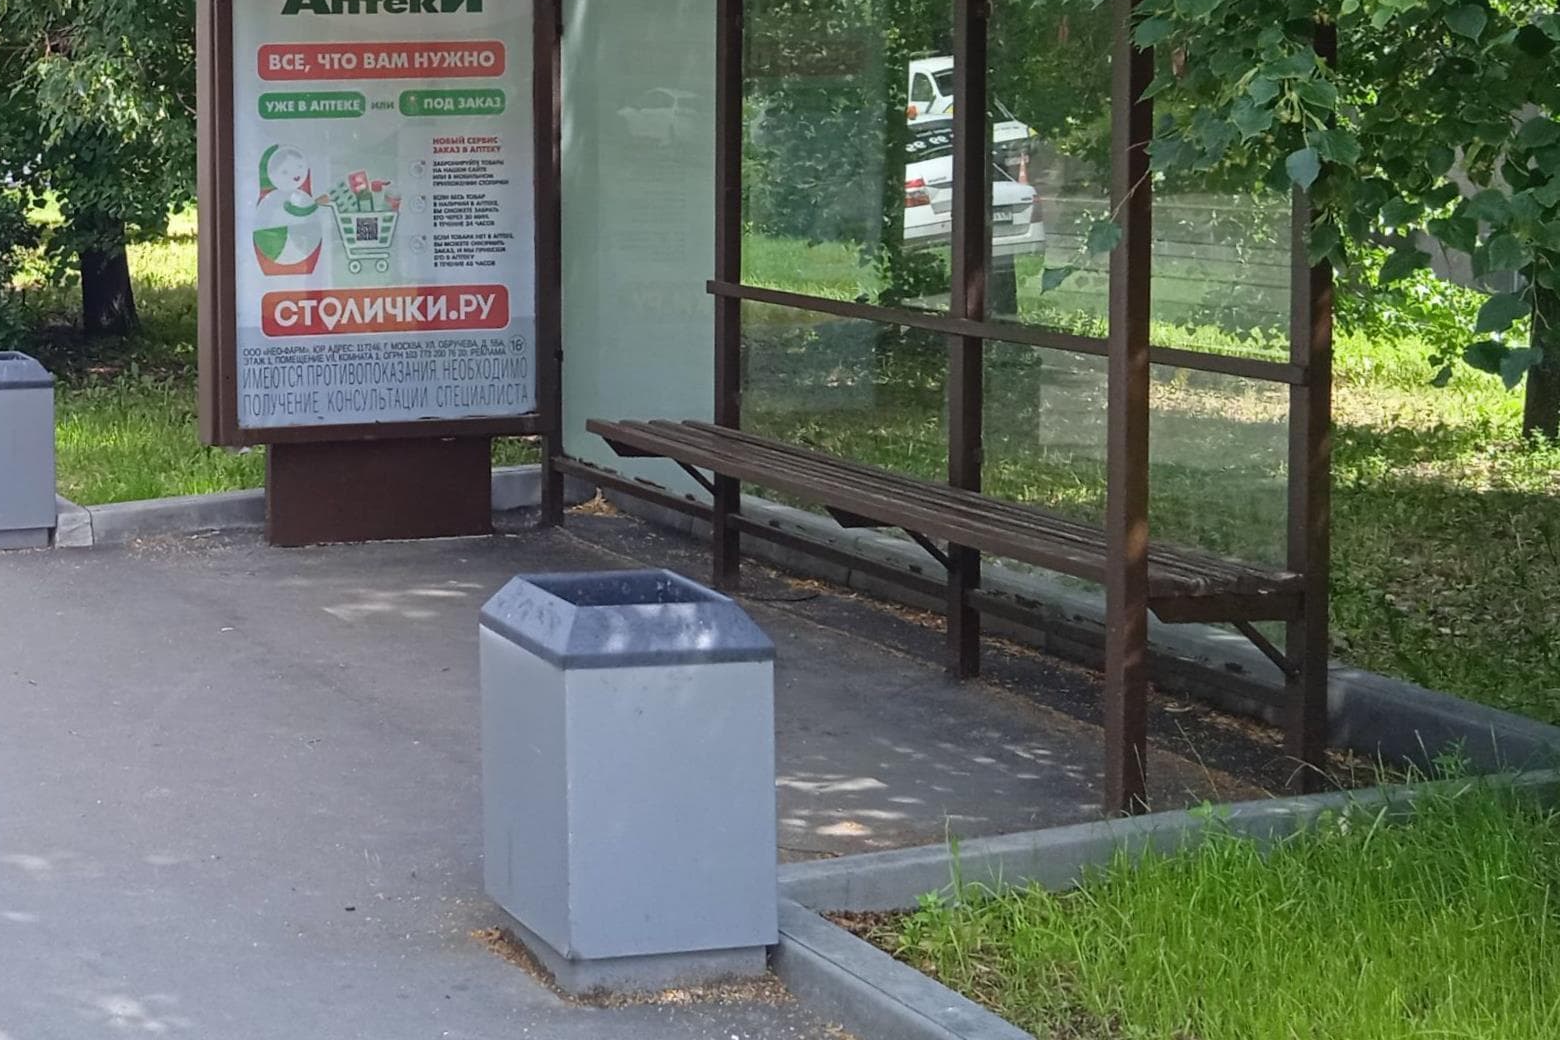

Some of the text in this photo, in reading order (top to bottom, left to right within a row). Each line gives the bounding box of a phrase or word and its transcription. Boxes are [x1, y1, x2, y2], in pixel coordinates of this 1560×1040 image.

[268, 50, 496, 72] ВСЕ, ЧТО ВАМ НУЖНО
[265, 99, 361, 112] УЖЕ В АПТЕКЕ
[371, 101, 394, 110] ИЛИ
[423, 96, 502, 111] ПОД ЗАКАЗ
[433, 136, 498, 145] НОВЫЙ СЕРВИС
[433, 146, 460, 154] ЗАКАЗ
[469, 145, 501, 153] АПТЕКУ
[274, 293, 496, 331] СТОЛИЧКИ.РУ
[243, 348, 261, 357] ООО
[243, 364, 303, 389] ИМЕЮТСЯ
[443, 356, 528, 381] НЕОБХОДИМО
[243, 383, 528, 416] ПОЛУЧЕНИЕ КОНСУЛЬТАЦИИ СПЕЦИАЛИСТА
